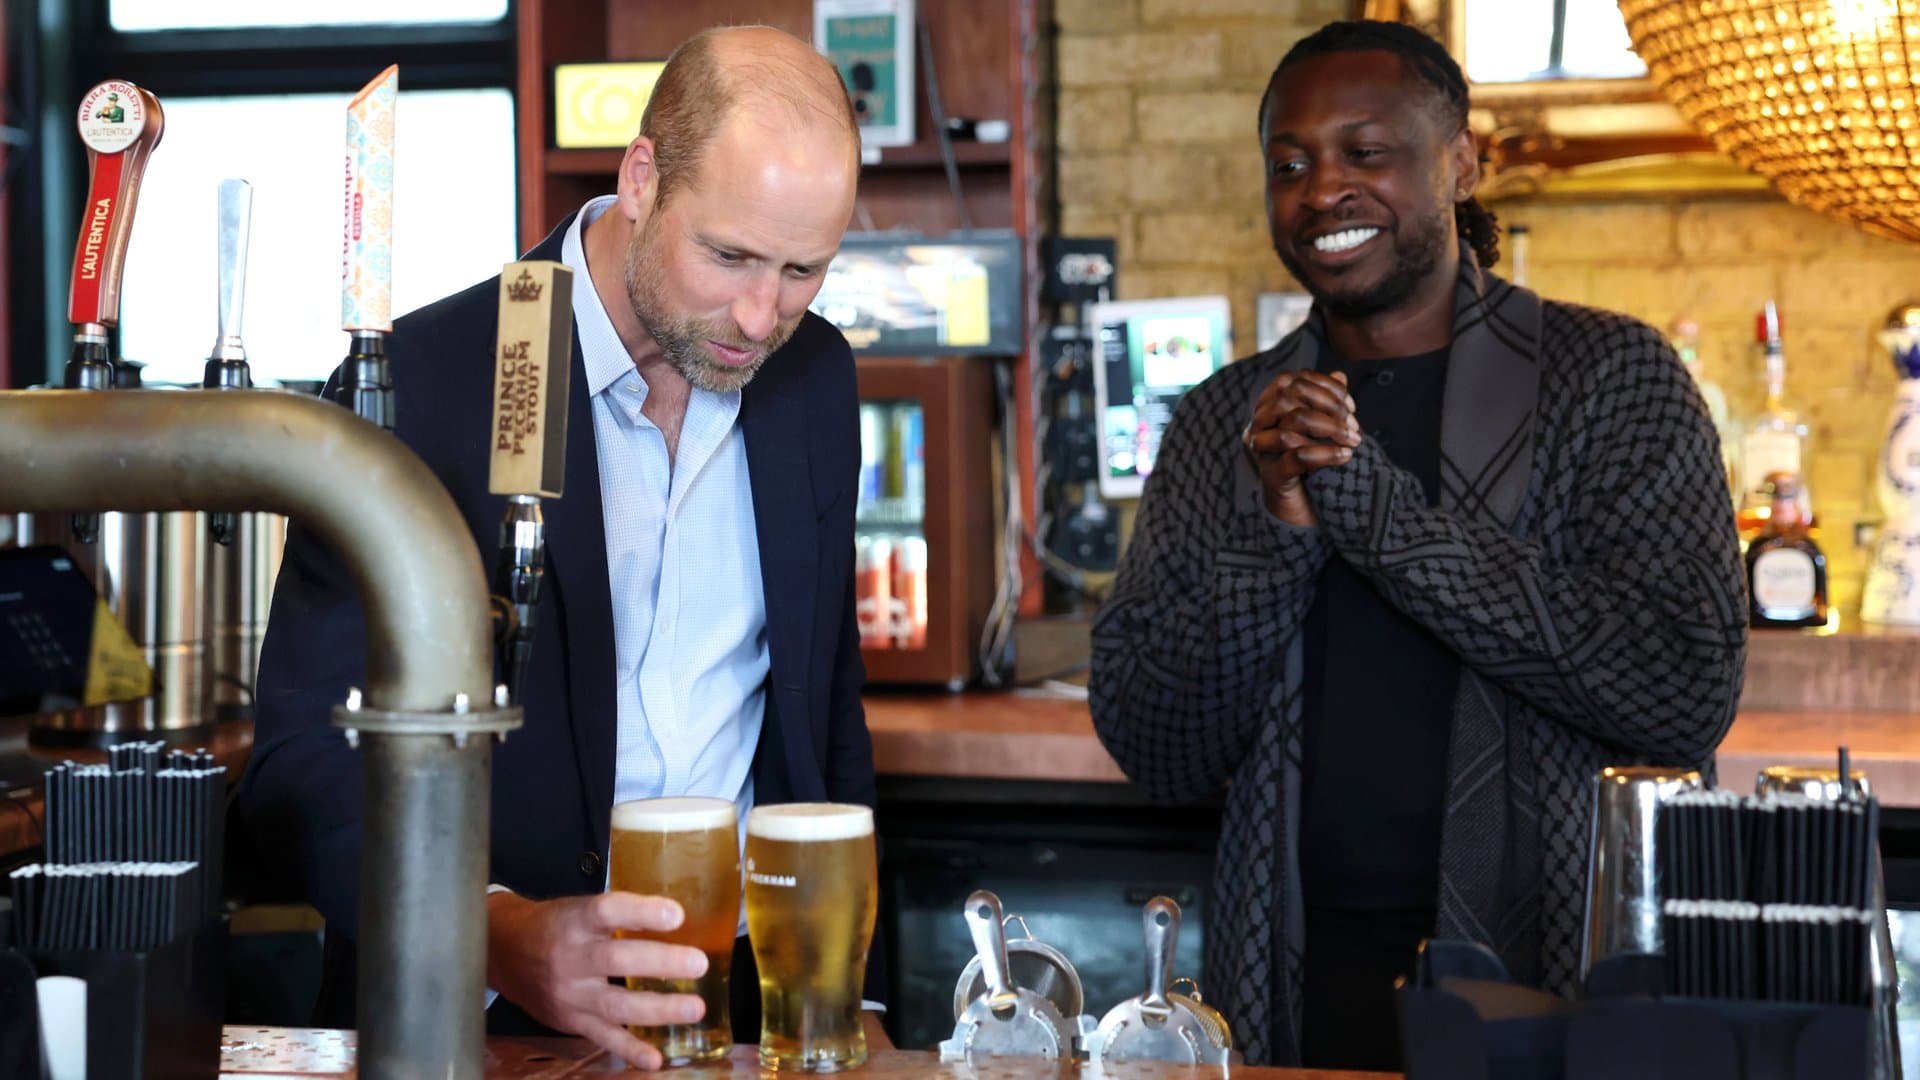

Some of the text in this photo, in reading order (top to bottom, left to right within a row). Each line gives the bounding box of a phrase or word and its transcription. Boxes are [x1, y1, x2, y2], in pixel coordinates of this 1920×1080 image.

[82, 83, 141, 121] BIRRA MORETTI
[81, 198, 112, 280] L'AUTENTICA
[353, 195, 362, 238] SEVILLA
[497, 343, 518, 451] PRINCE
[513, 340, 531, 456] PECKHAM
[526, 362, 541, 435] STOUT
